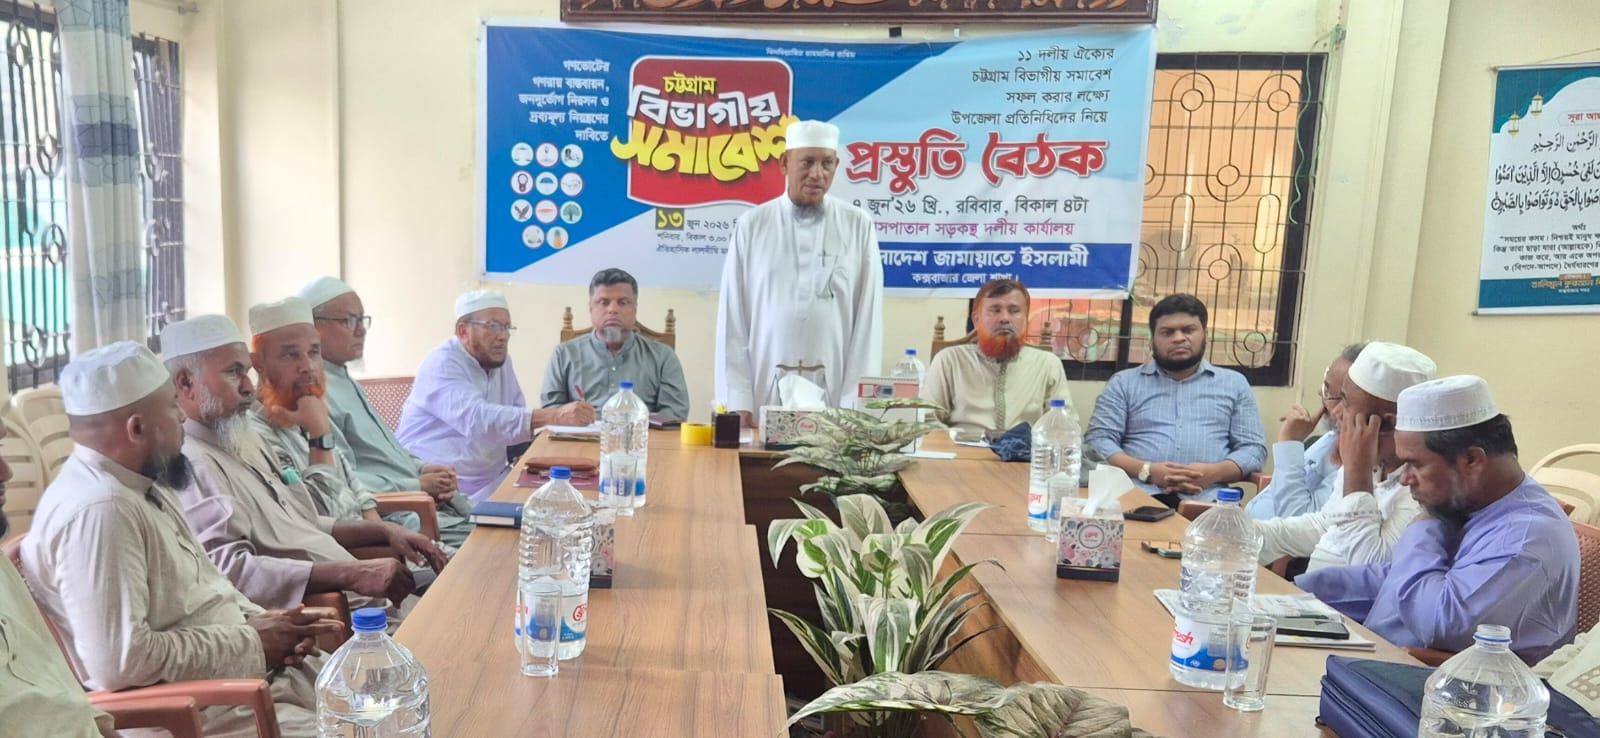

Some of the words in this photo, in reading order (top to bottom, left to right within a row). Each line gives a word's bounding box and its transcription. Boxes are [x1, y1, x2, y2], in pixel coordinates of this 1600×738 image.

[1018, 50, 1032, 61] ১১
[1039, 46, 1069, 60] দলীয়
[1073, 44, 1115, 60] ঐক্যের
[663, 71, 717, 95] চট্টগ্রাম
[972, 68, 1010, 83] চট্টগ্রাম
[1014, 66, 1061, 83] বিভাগীয়
[1066, 68, 1112, 82] সমাবেশ
[601, 97, 609, 106] ও
[1006, 92, 1037, 103] সফল
[1042, 91, 1072, 103] করার
[1077, 89, 1111, 102] লক্ষ্যে
[627, 84, 781, 129] বিভাগীয়
[951, 110, 1001, 125] উপজেলা
[1005, 109, 1076, 125] প্রতিনিধিদের
[1081, 107, 1109, 123] নিয়ে
[574, 127, 609, 141] দাবিতে
[846, 128, 966, 195] প্রস্তুতি
[981, 131, 1107, 186] বৈঠক
[1015, 195, 1059, 213] বিকাল
[1064, 196, 1089, 213] ৪টা
[657, 209, 683, 228] ১৩
[703, 220, 730, 230] ২০২৬
[984, 217, 1018, 236] দলীয়
[1024, 218, 1075, 236] কার্যালয়
[933, 249, 1016, 268] জামায়াতে
[1020, 243, 1089, 267] ইসলামী
[1172, 629, 1194, 647] resh
